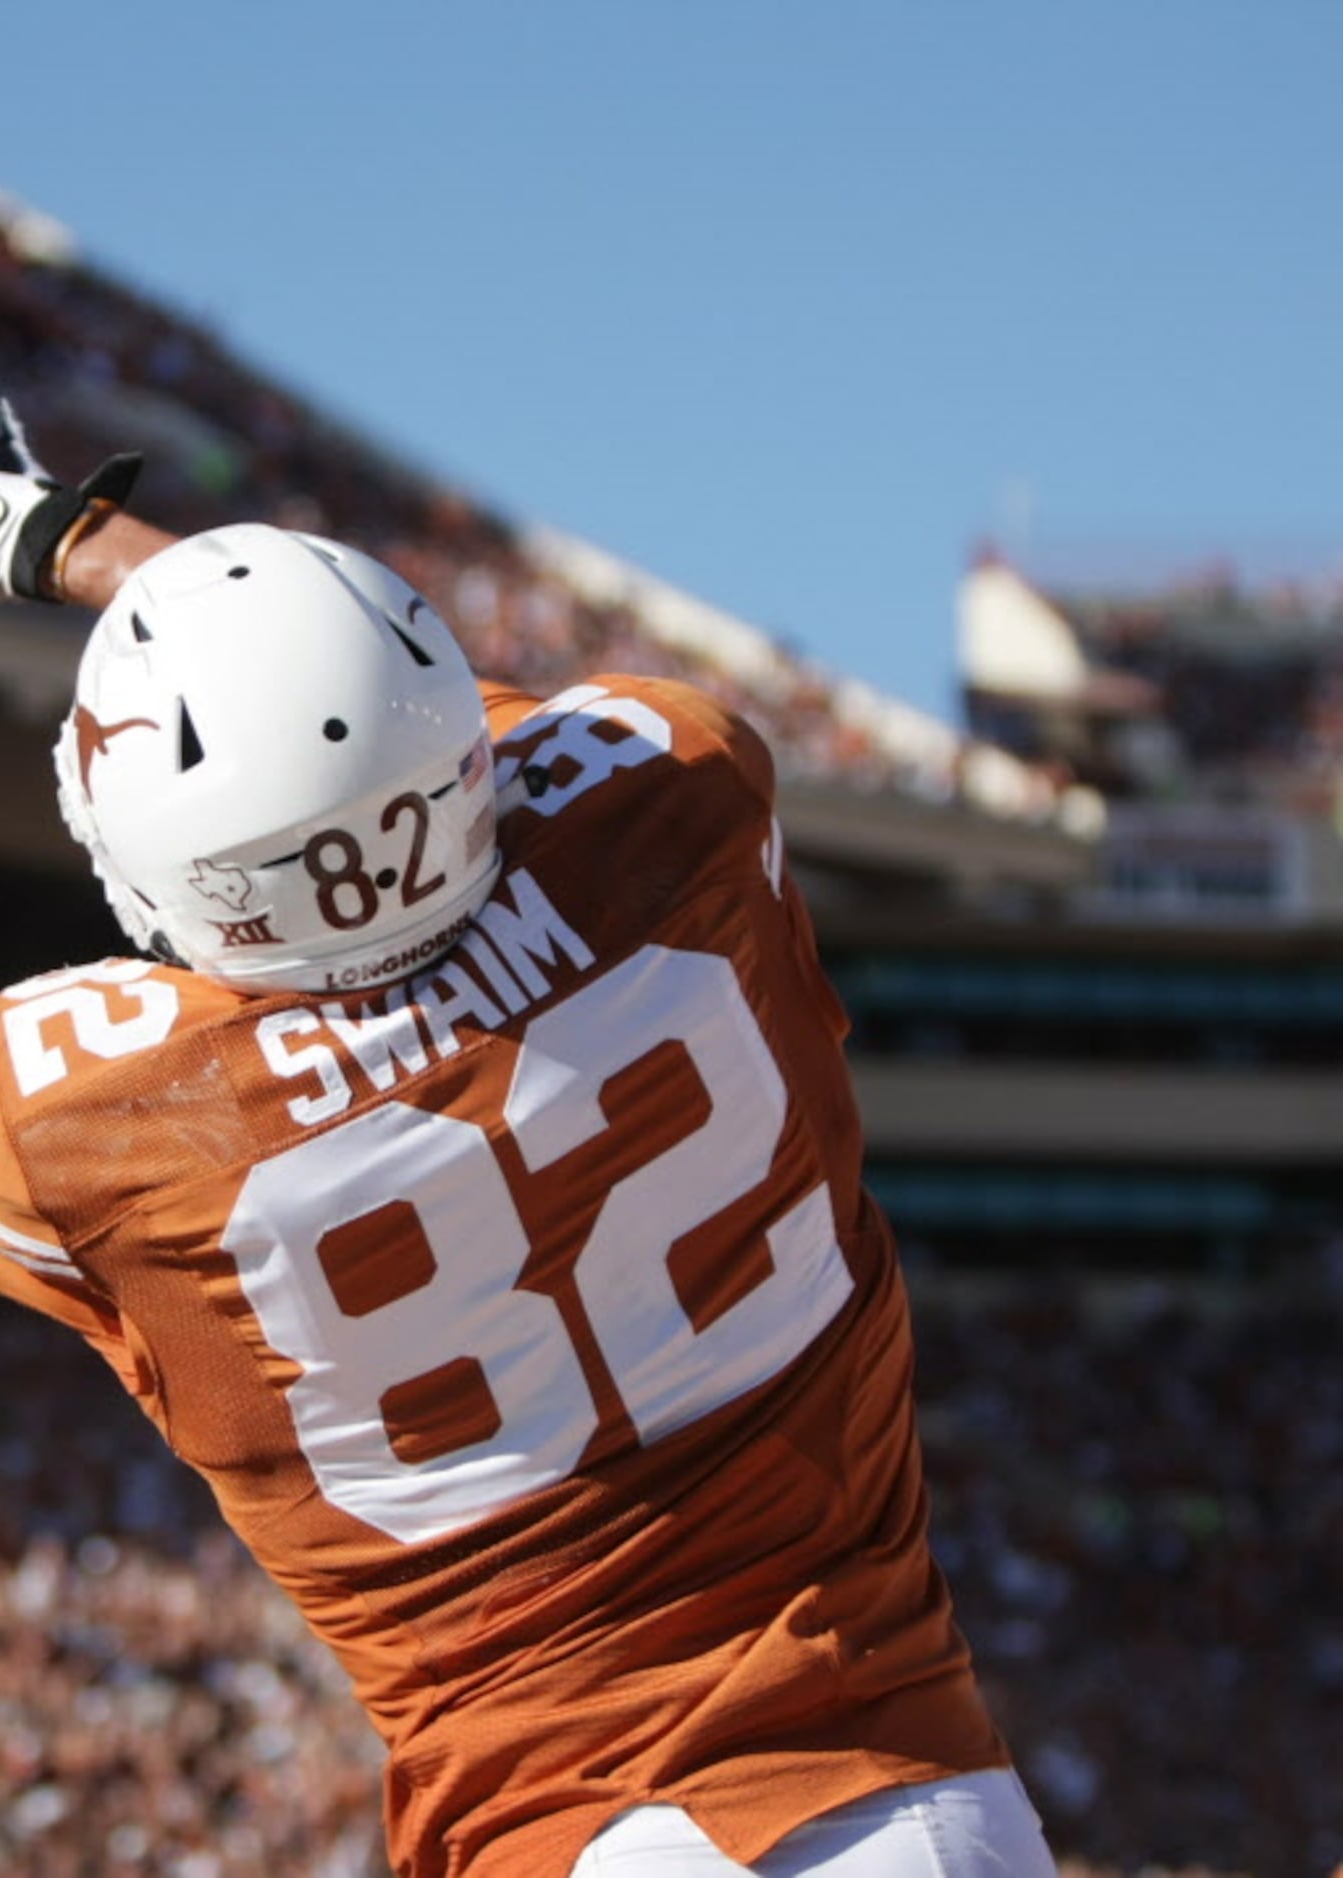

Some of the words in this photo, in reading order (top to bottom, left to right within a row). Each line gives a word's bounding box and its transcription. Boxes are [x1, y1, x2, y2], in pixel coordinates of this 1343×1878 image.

[304, 790, 446, 930] 82
[255, 866, 597, 1127] SWAIM
[219, 943, 855, 1544] 82
